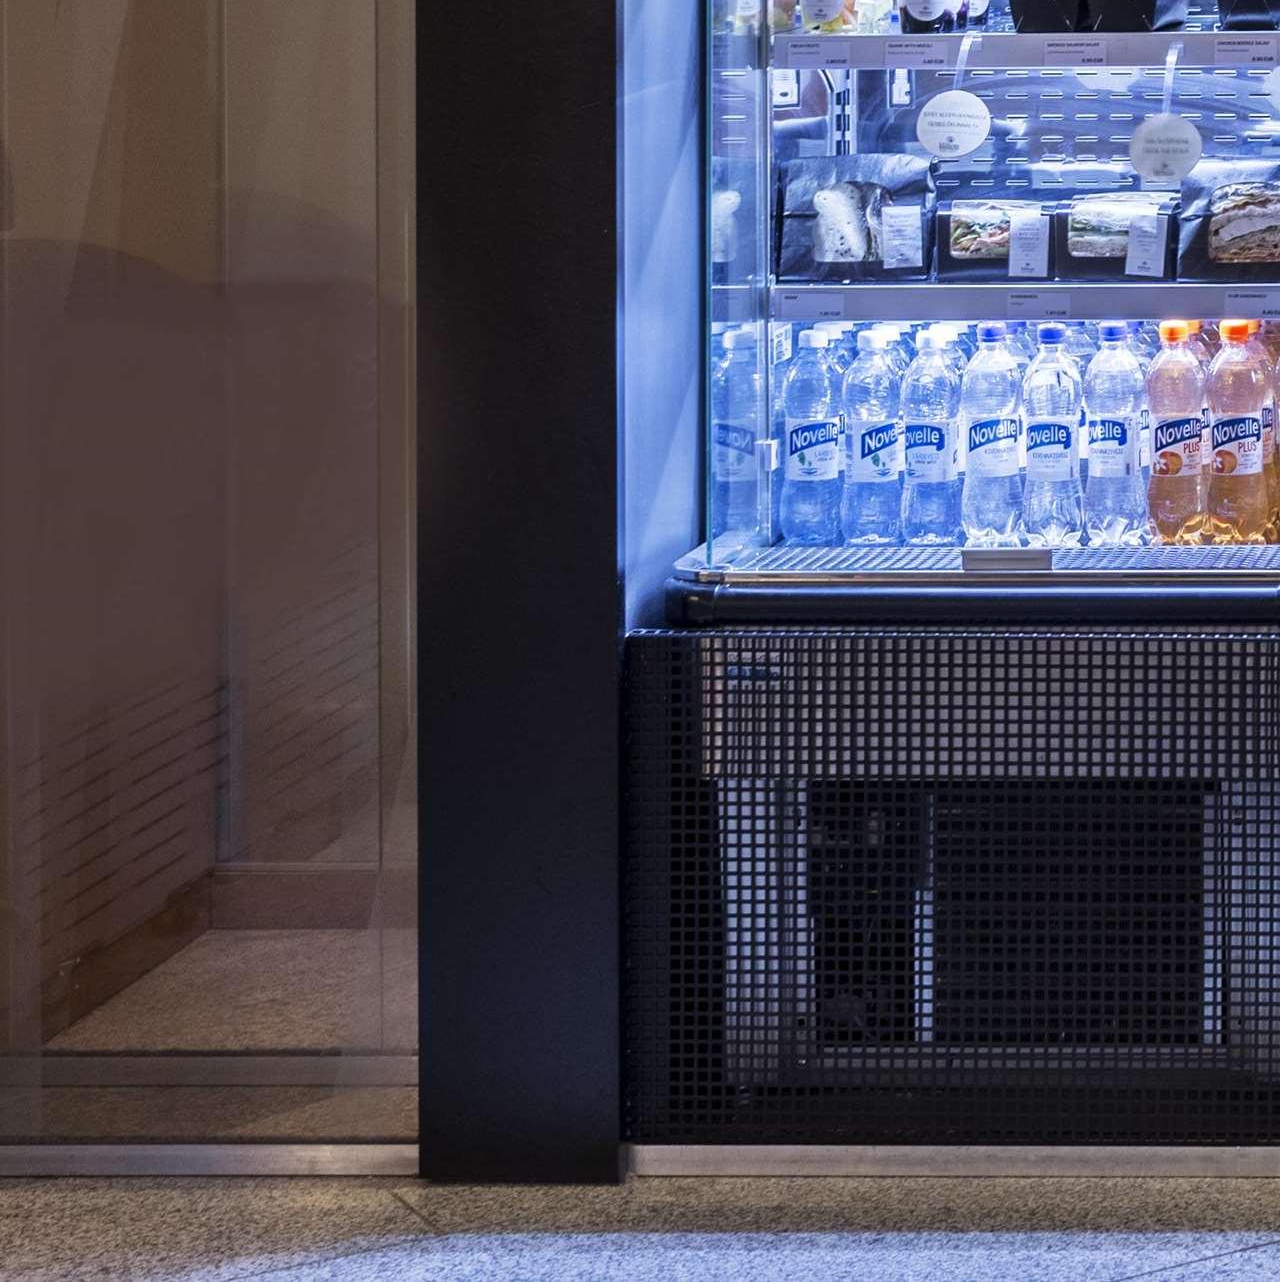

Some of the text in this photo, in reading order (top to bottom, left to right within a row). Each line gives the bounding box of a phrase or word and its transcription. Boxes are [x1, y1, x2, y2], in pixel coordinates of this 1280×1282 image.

[792, 423, 838, 451] Novelle
[906, 426, 940, 446] ovelle
[970, 419, 1017, 448] Novelle
[1088, 422, 1122, 441] ovelle
[1157, 419, 1201, 448] Novelle
[1212, 419, 1260, 447] Novelle
[1183, 440, 1201, 453] PLUS
[1237, 440, 1257, 452] PLUS
